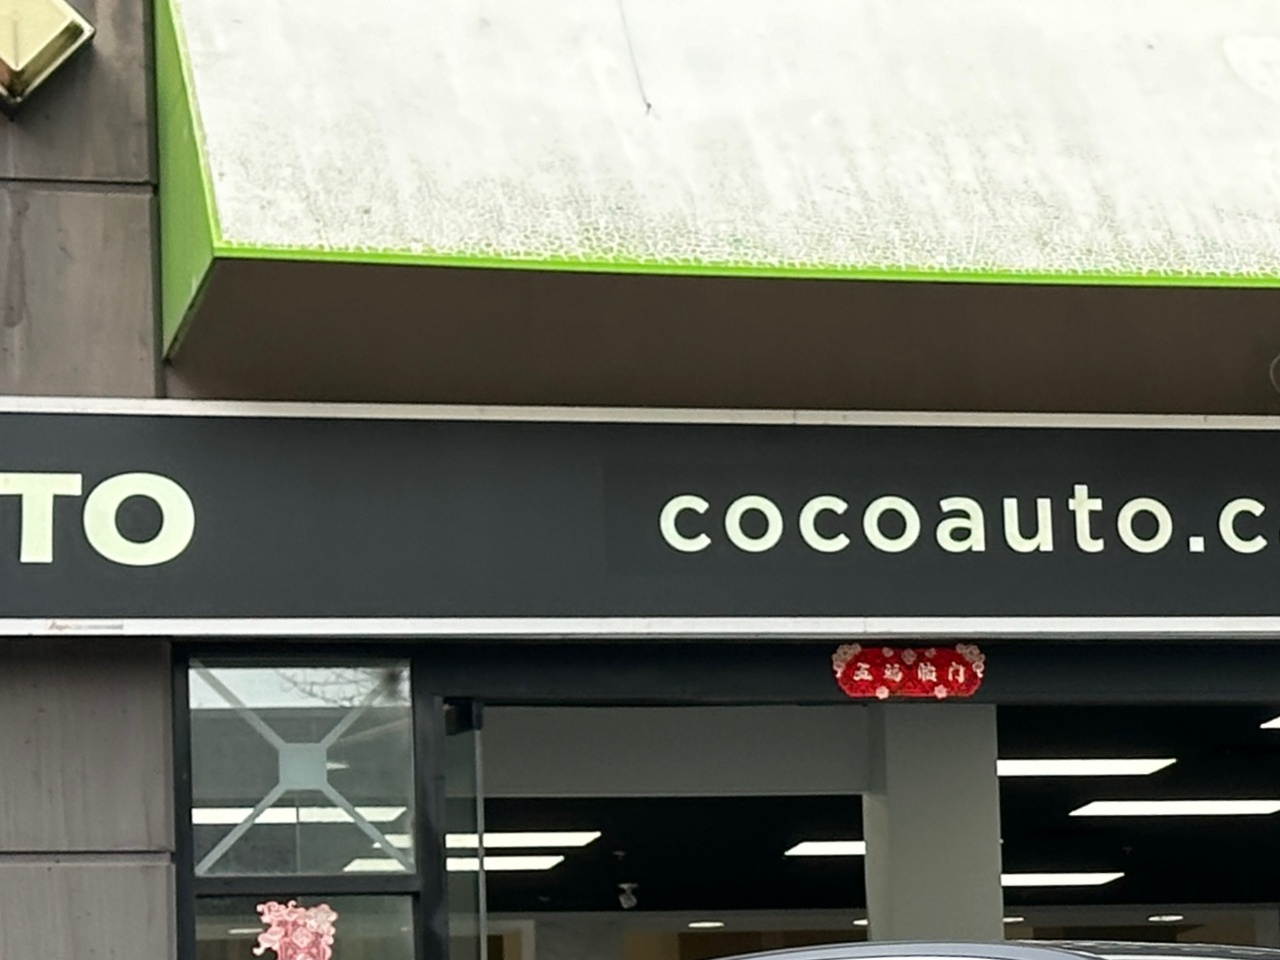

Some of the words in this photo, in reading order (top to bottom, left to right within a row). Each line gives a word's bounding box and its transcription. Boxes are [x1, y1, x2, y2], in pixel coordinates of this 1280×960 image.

[0, 472, 196, 567] TO
[852, 661, 966, 683] 五福临门
